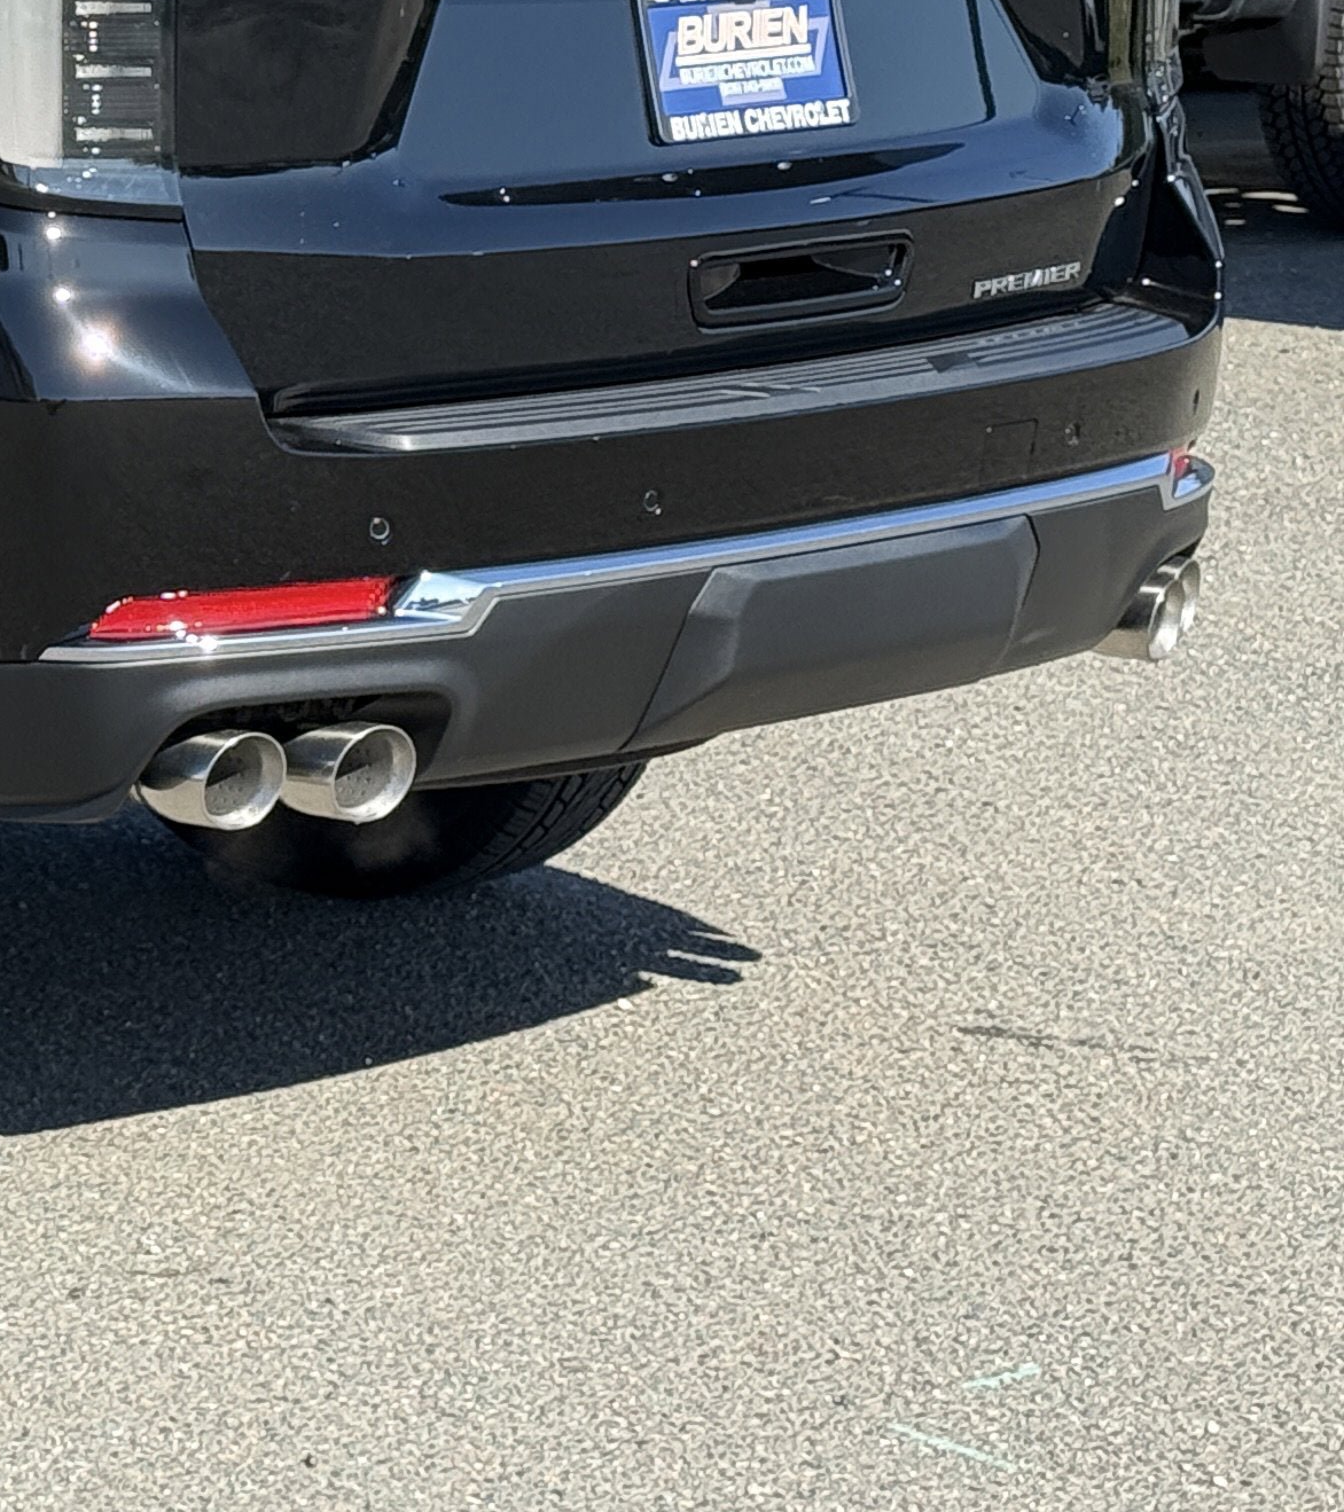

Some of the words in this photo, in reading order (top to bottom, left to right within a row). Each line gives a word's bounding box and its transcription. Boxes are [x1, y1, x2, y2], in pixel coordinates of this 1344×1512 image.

[677, 5, 809, 56] BURIEN
[669, 111, 743, 141] BURIEN
[744, 99, 851, 133] CHEVROLET
[973, 261, 1081, 299] PREMIER
